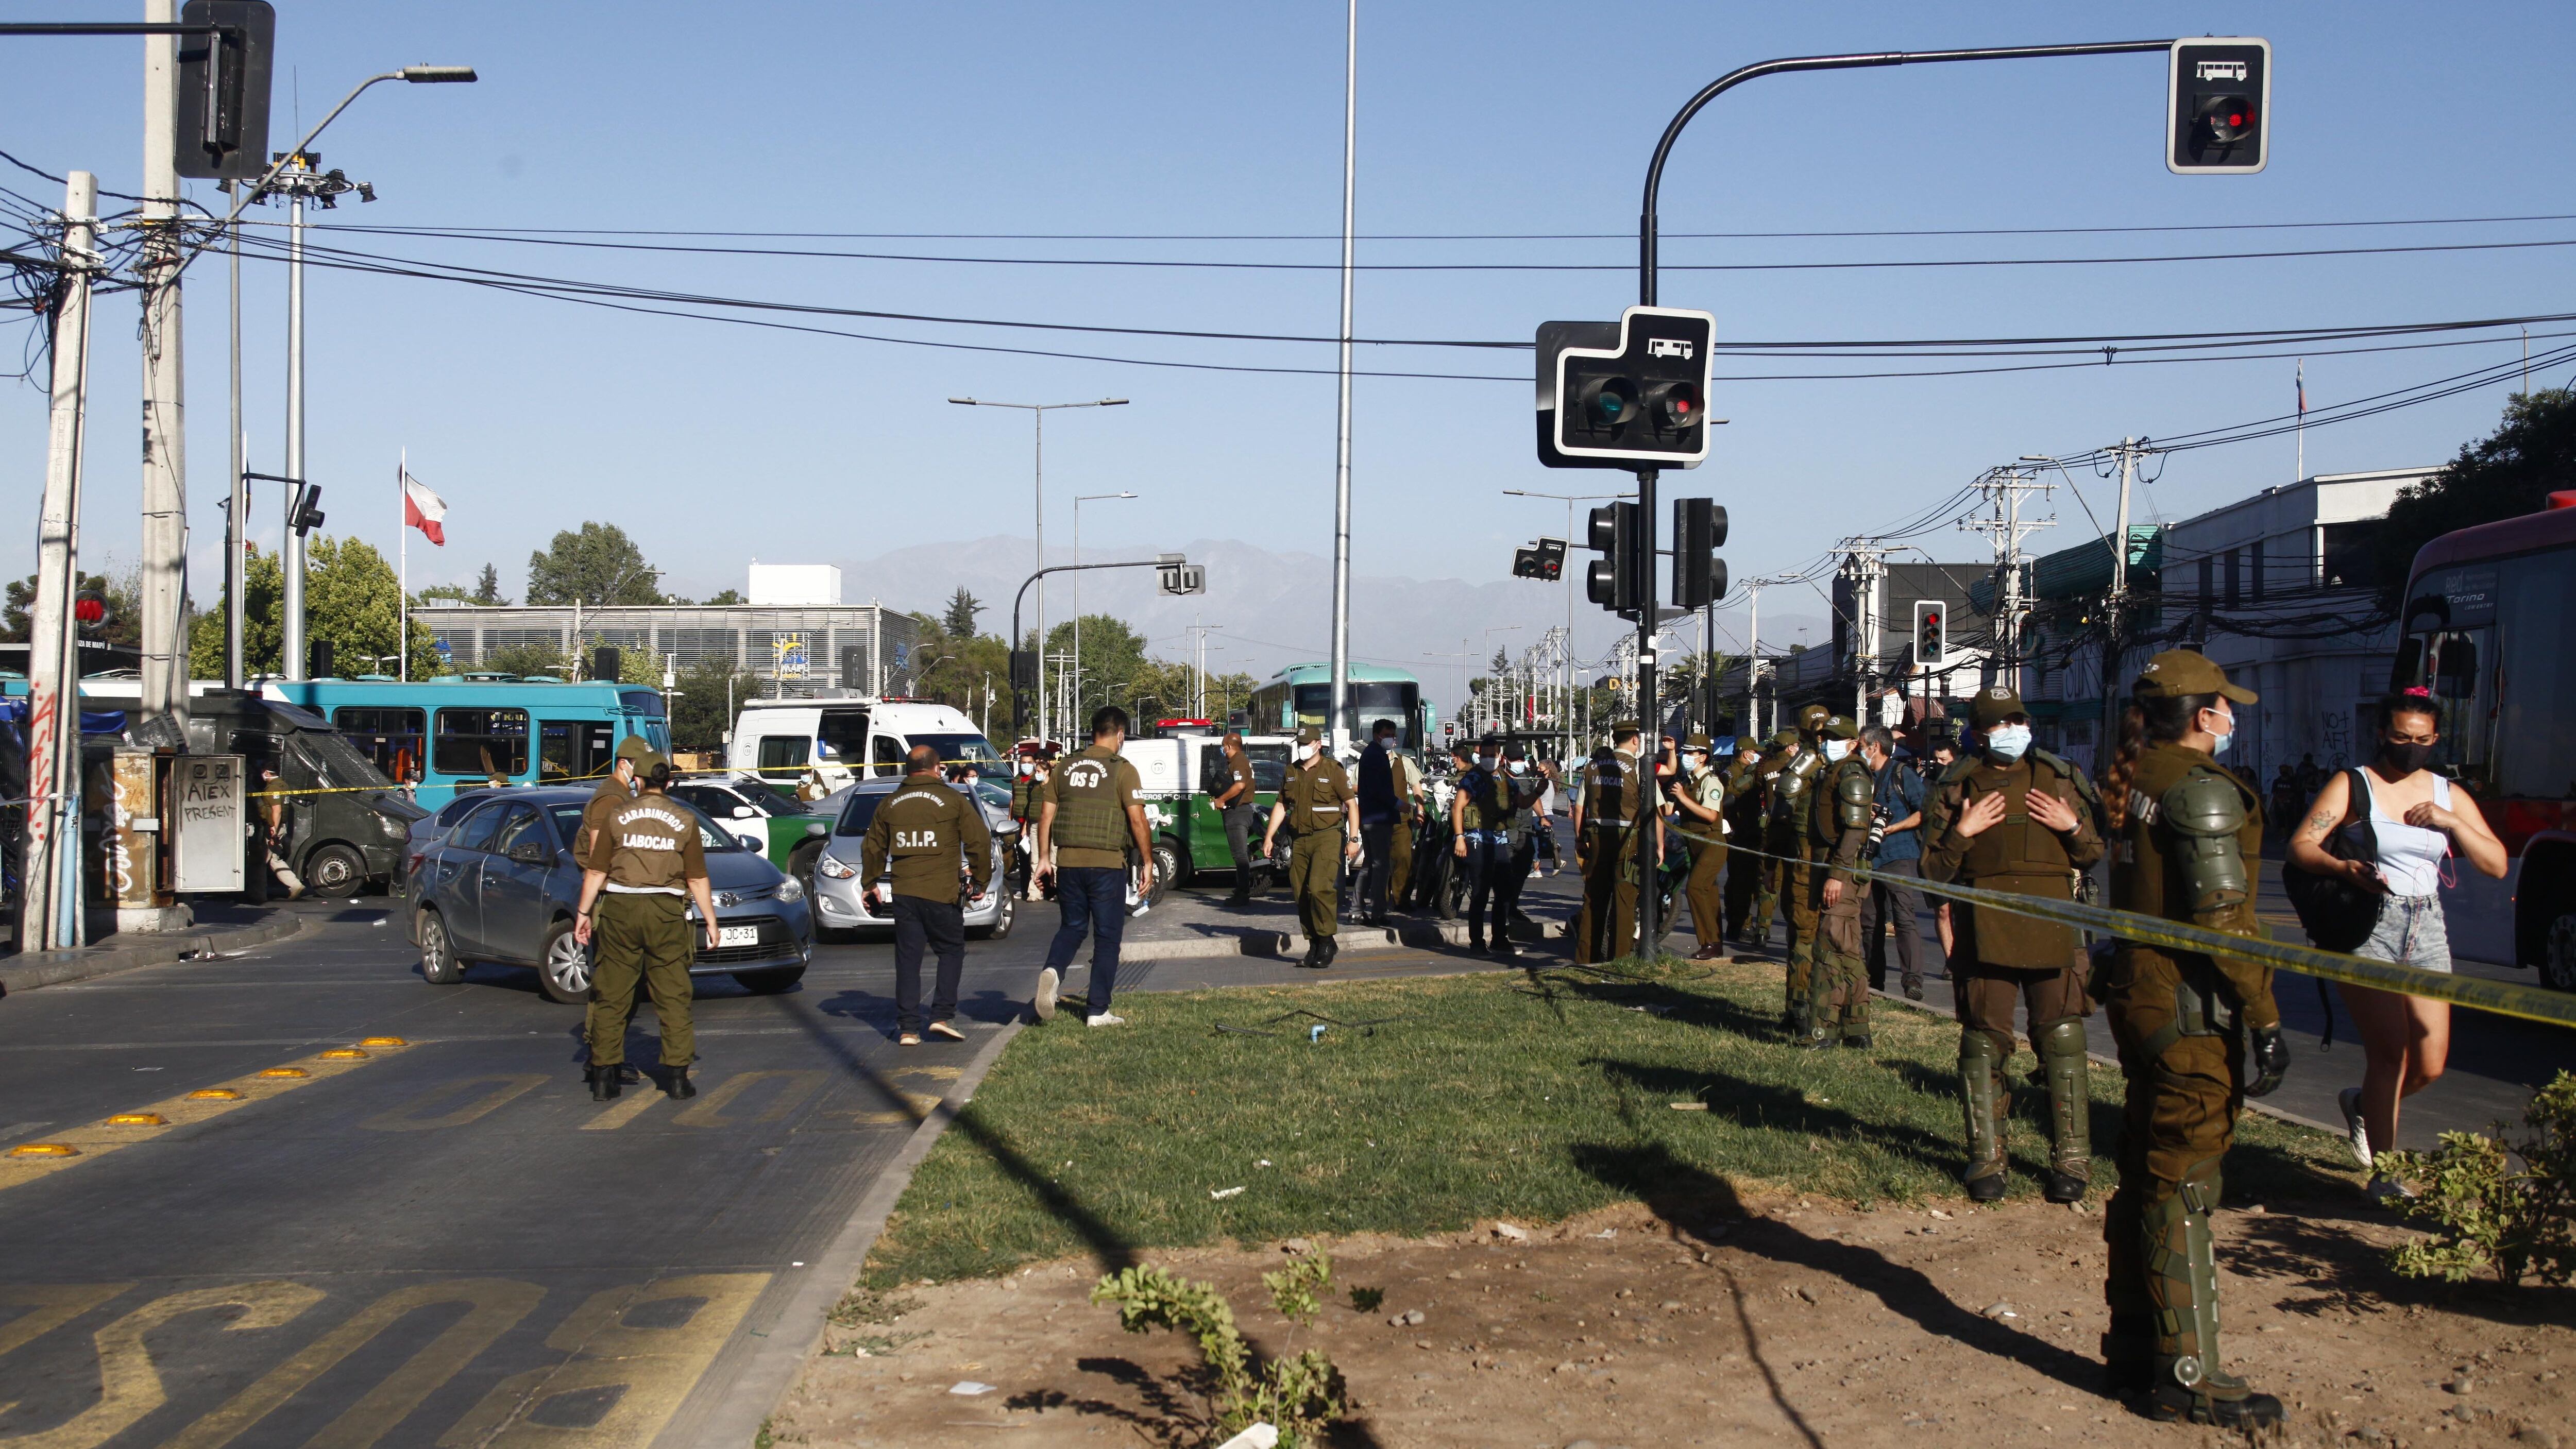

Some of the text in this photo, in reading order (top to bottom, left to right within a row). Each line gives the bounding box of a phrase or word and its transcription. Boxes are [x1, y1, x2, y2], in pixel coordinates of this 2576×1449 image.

[2446, 593, 2485, 604] Torino
[1064, 759, 1108, 778] CARABINEROS
[1591, 759, 1632, 773] CARABINEROS
[1070, 772, 1099, 788] OS 9
[1591, 775, 1624, 788] LABOCAR
[930, 794, 945, 807] CHILE
[618, 808, 685, 832] CARABINEROS
[623, 833, 675, 850] LABOCAR
[896, 831, 937, 848] S.I.P.
